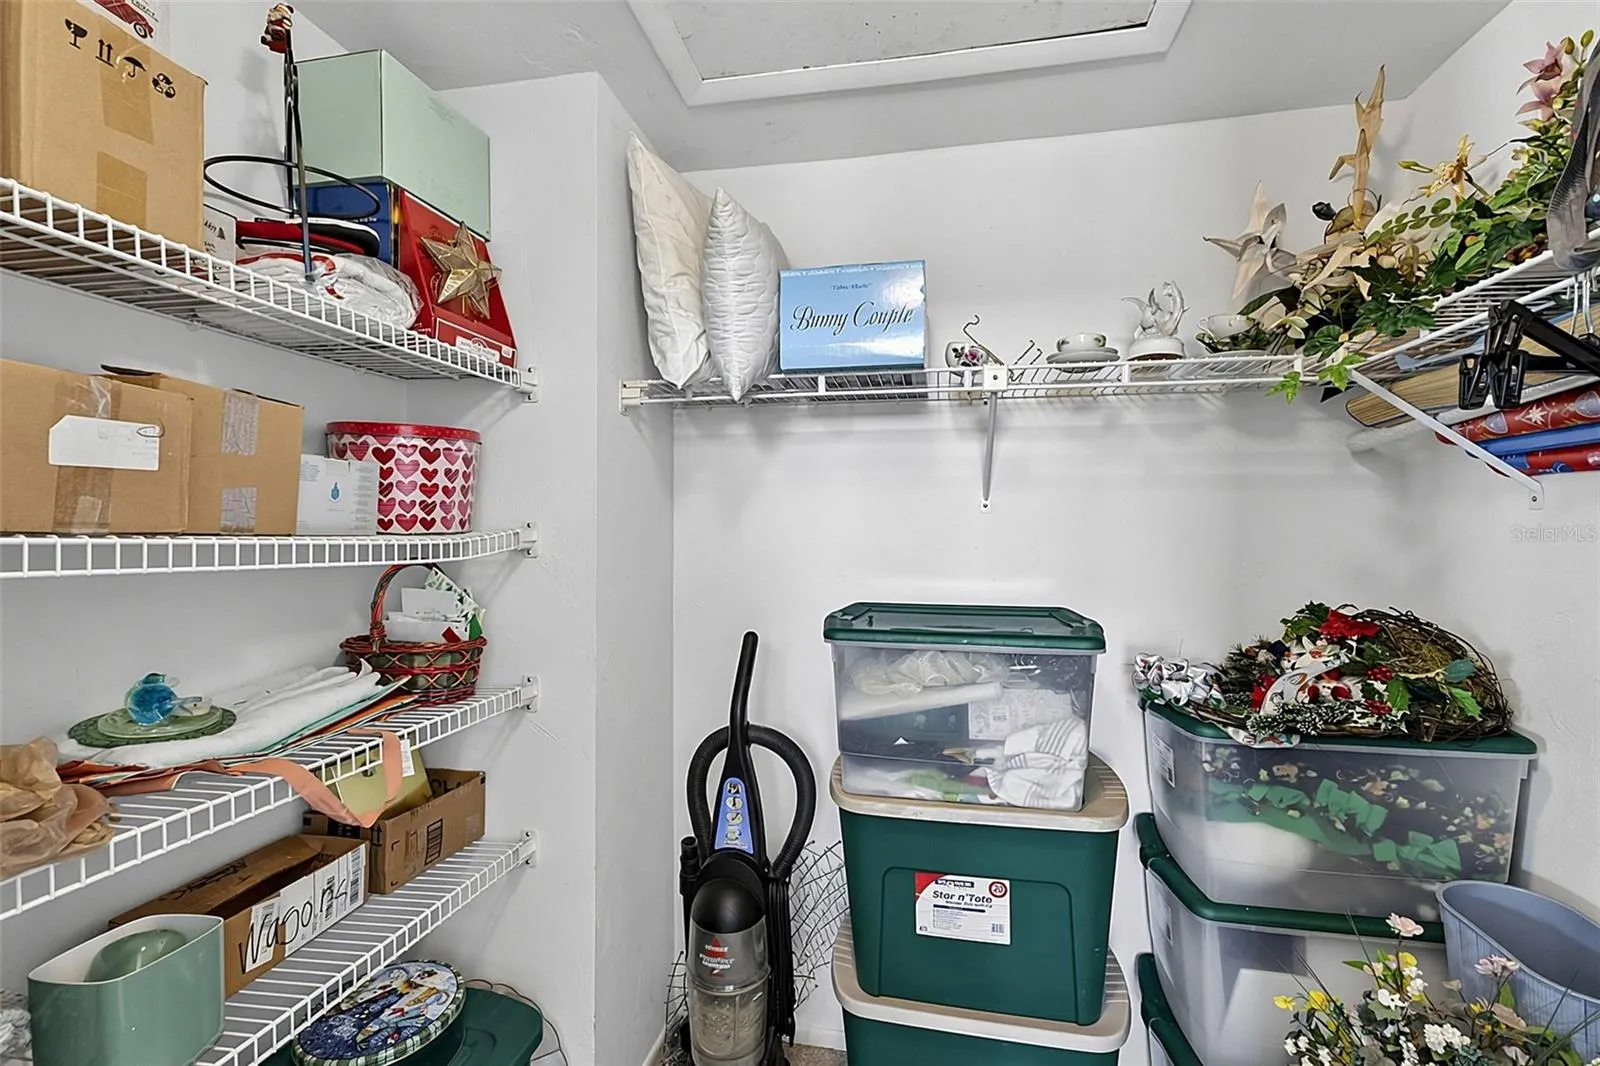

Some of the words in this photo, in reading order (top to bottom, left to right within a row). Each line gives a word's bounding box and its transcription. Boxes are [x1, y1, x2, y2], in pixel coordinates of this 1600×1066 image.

[790, 303, 849, 336] Bunny
[853, 300, 914, 333] Couple
[932, 890, 955, 900] Stor
